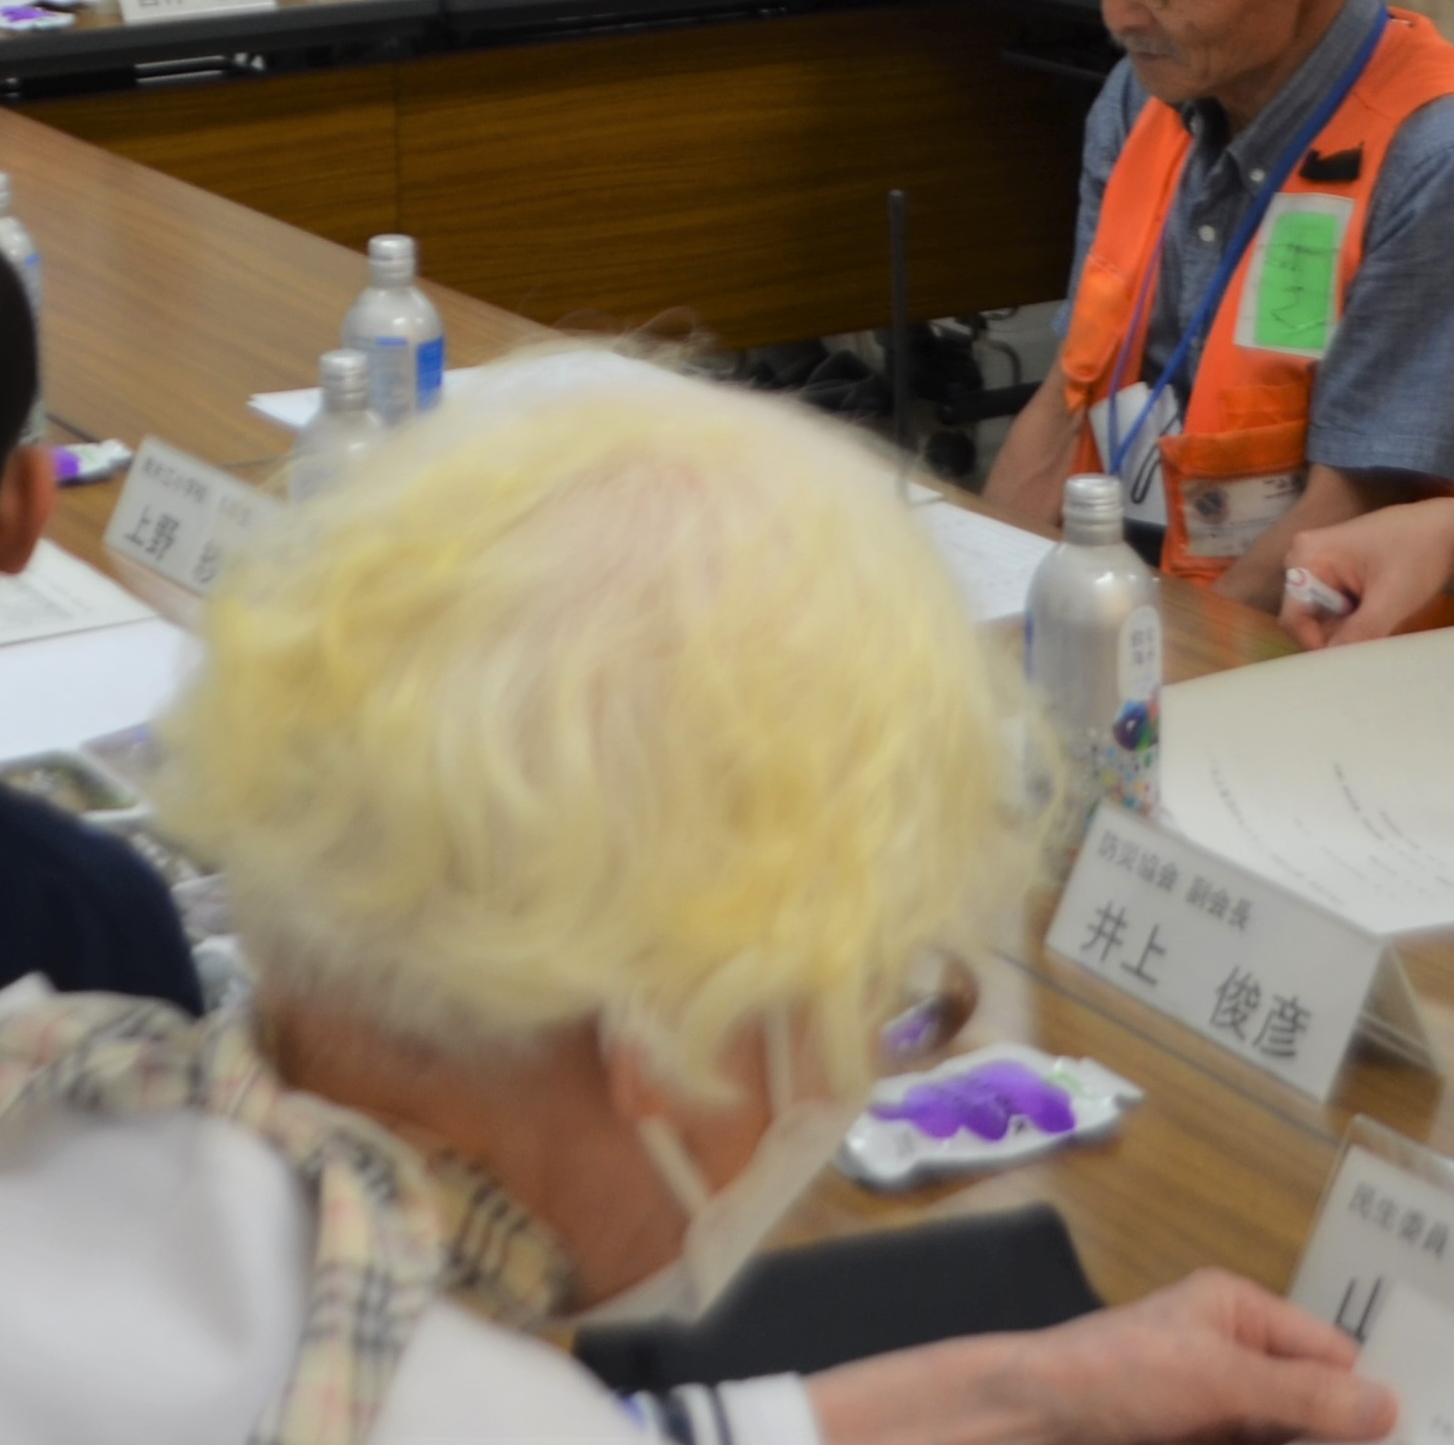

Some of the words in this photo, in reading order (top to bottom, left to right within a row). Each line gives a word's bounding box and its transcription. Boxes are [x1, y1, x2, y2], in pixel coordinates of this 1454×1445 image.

[1098, 829, 1178, 892] 防災協会
[1185, 874, 1252, 932] 副会長
[1079, 899, 1167, 989] 井上
[1209, 964, 1312, 1058] 俊彦
